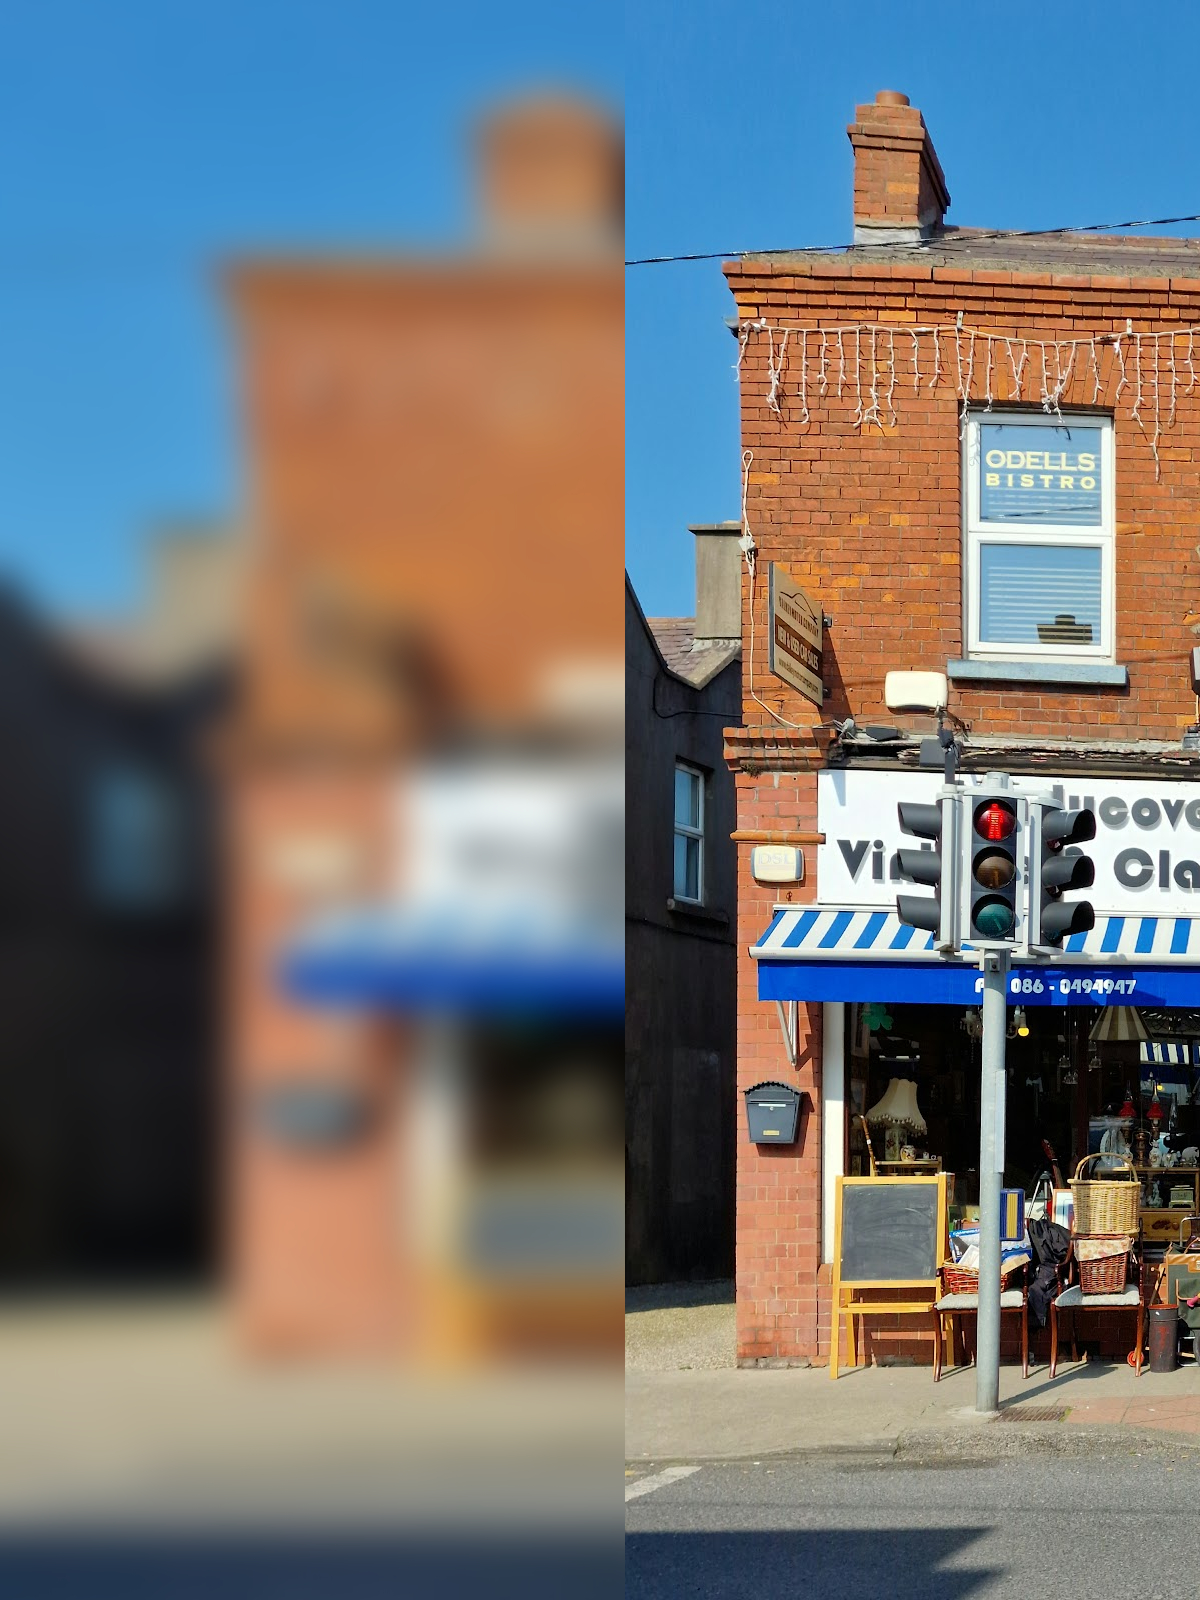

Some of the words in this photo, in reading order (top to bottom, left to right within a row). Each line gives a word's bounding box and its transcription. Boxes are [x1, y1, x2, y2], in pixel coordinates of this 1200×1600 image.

[985, 449, 1096, 472] ODELLS
[985, 473, 1096, 490] BISTRO
[777, 624, 787, 647] NEW
[808, 649, 819, 671] SALES
[1010, 977, 1044, 994] 086
[1059, 978, 1137, 995] 0494947
